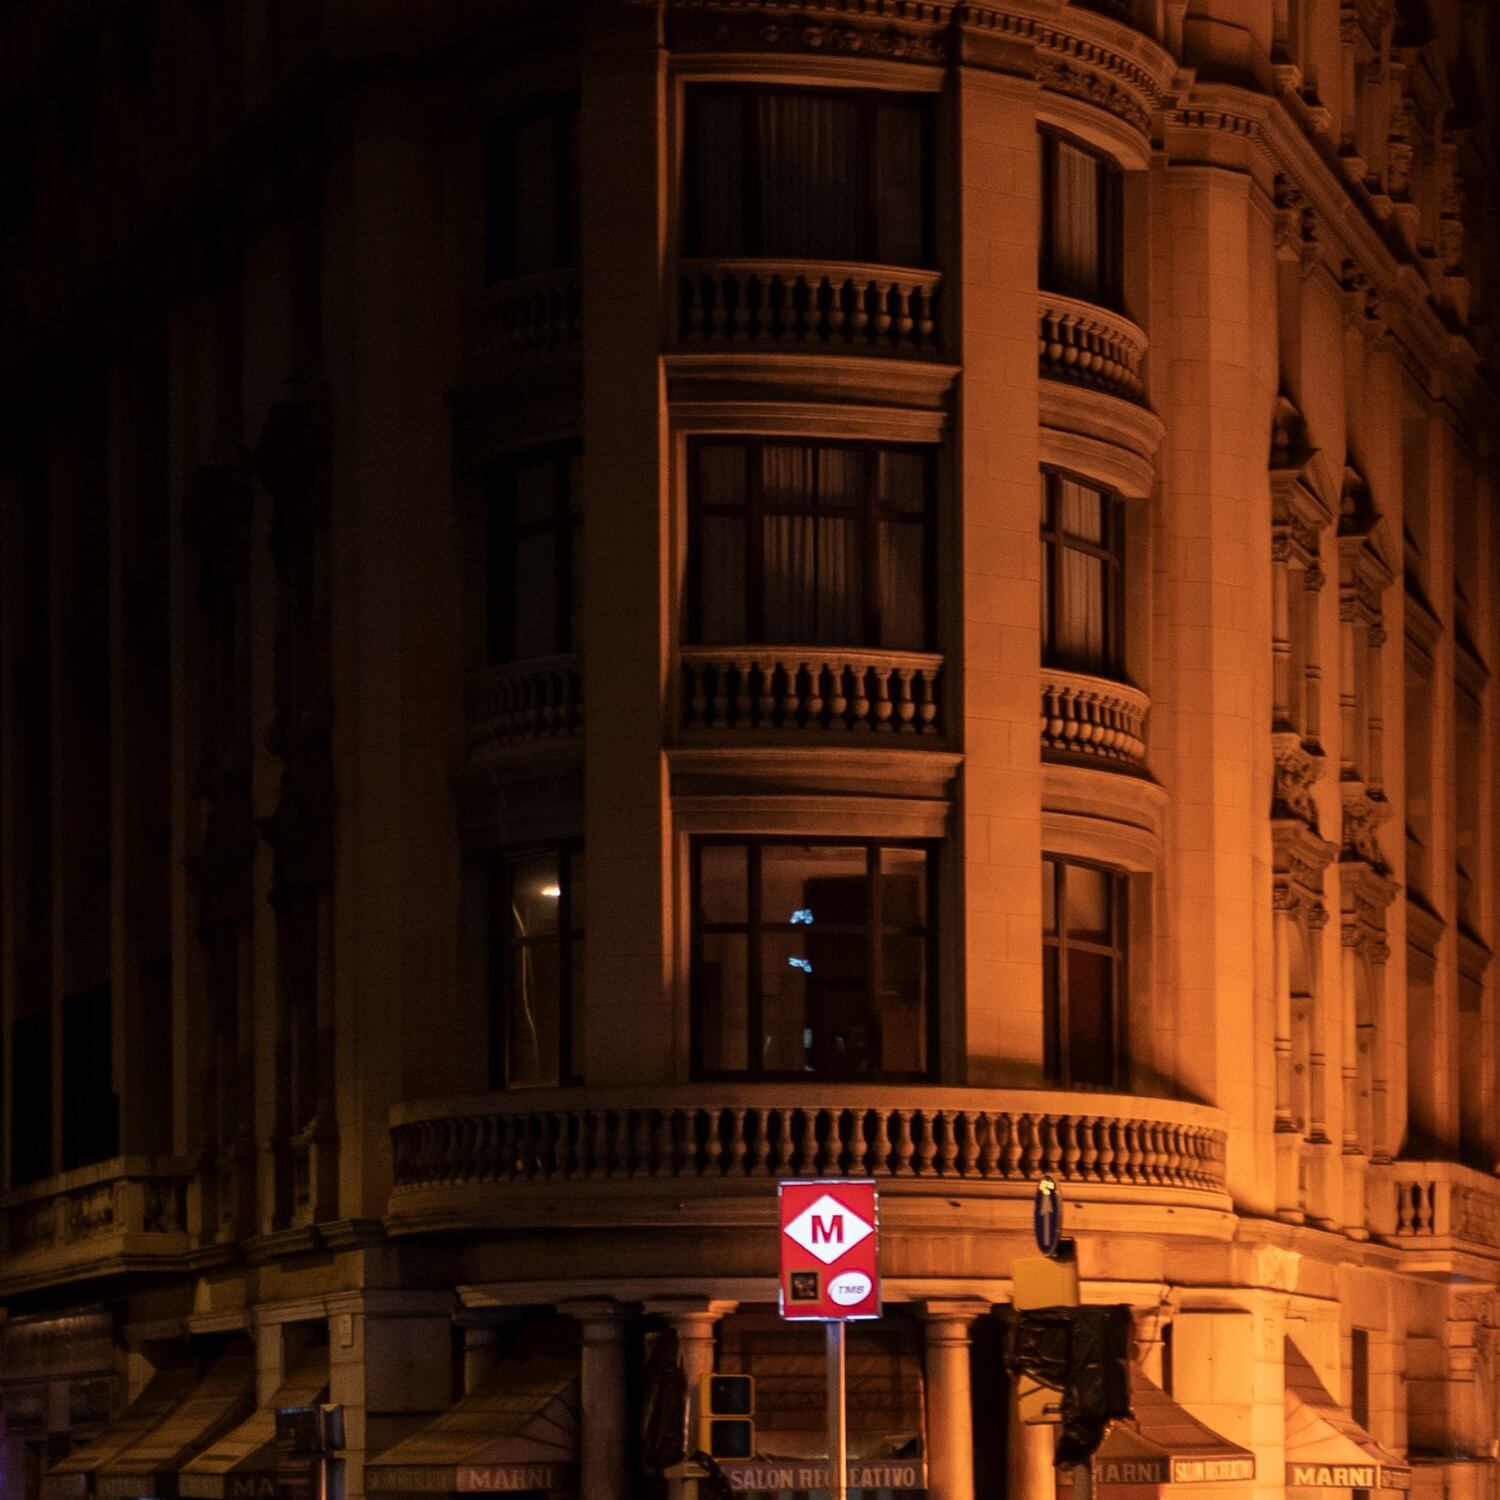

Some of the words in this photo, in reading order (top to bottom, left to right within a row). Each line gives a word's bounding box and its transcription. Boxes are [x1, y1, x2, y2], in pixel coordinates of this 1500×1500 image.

[811, 1215, 844, 1244] M
[468, 1469, 553, 1489] MARNI
[730, 1468, 793, 1489] SALON
[799, 1467, 916, 1488] RECEATIVO
[1293, 1467, 1375, 1487] MARNI
